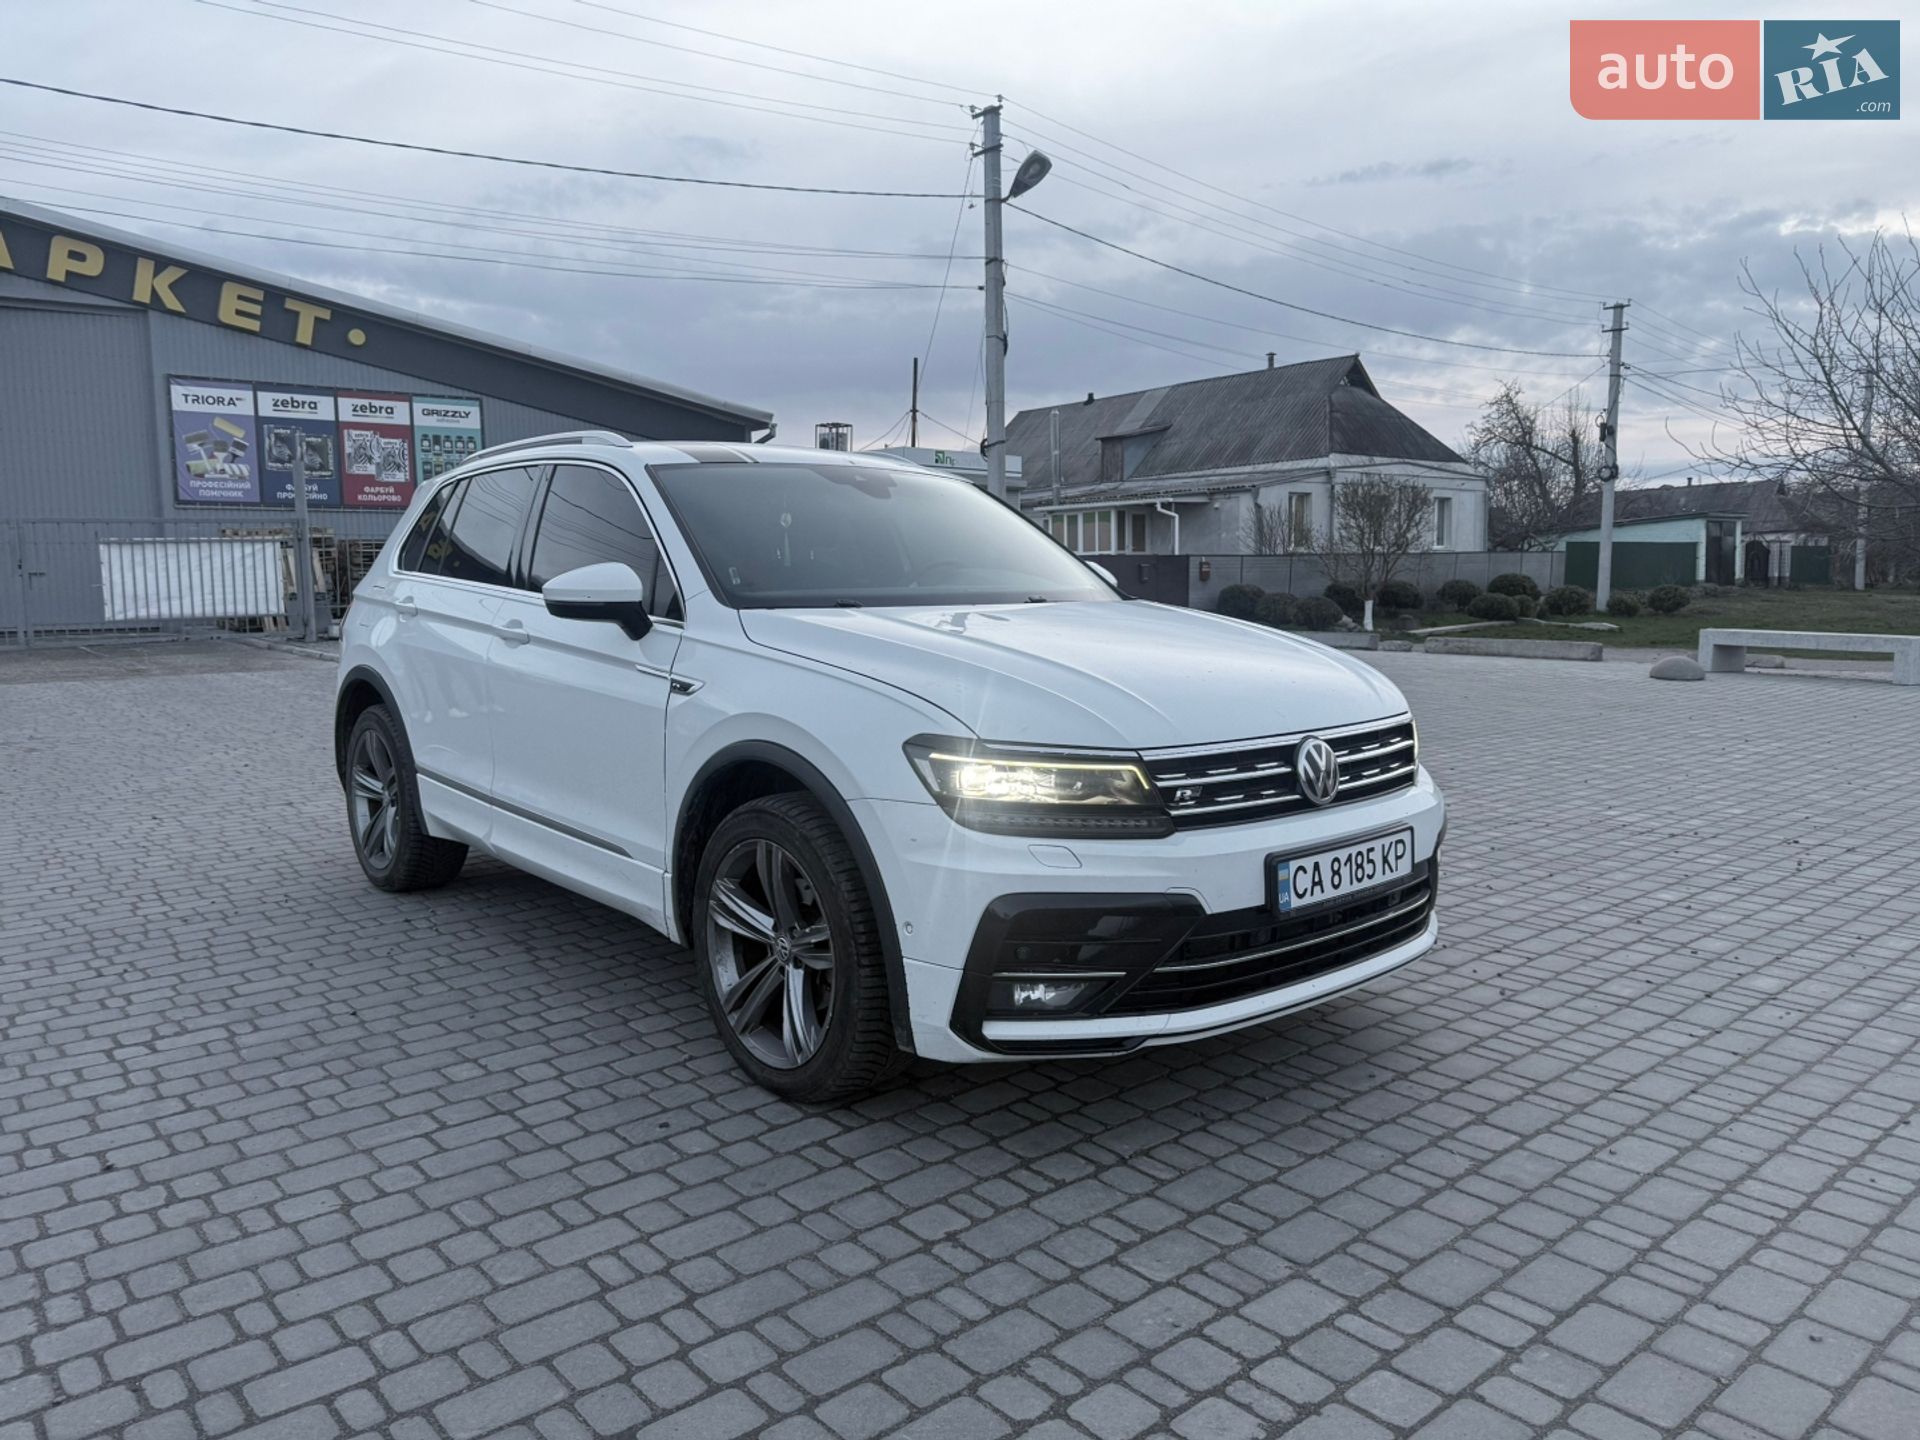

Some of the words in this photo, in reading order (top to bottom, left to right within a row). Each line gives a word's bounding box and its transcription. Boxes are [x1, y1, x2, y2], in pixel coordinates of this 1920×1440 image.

[182, 393, 237, 407] TRIORA
[272, 396, 318, 410] zebra
[352, 402, 395, 415] zebra
[421, 408, 471, 418] GRIZZLY
[1293, 861, 1324, 899] CA
[1331, 847, 1376, 890] 8185
[1381, 838, 1406, 876] KP
[1279, 891, 1289, 903] UA
